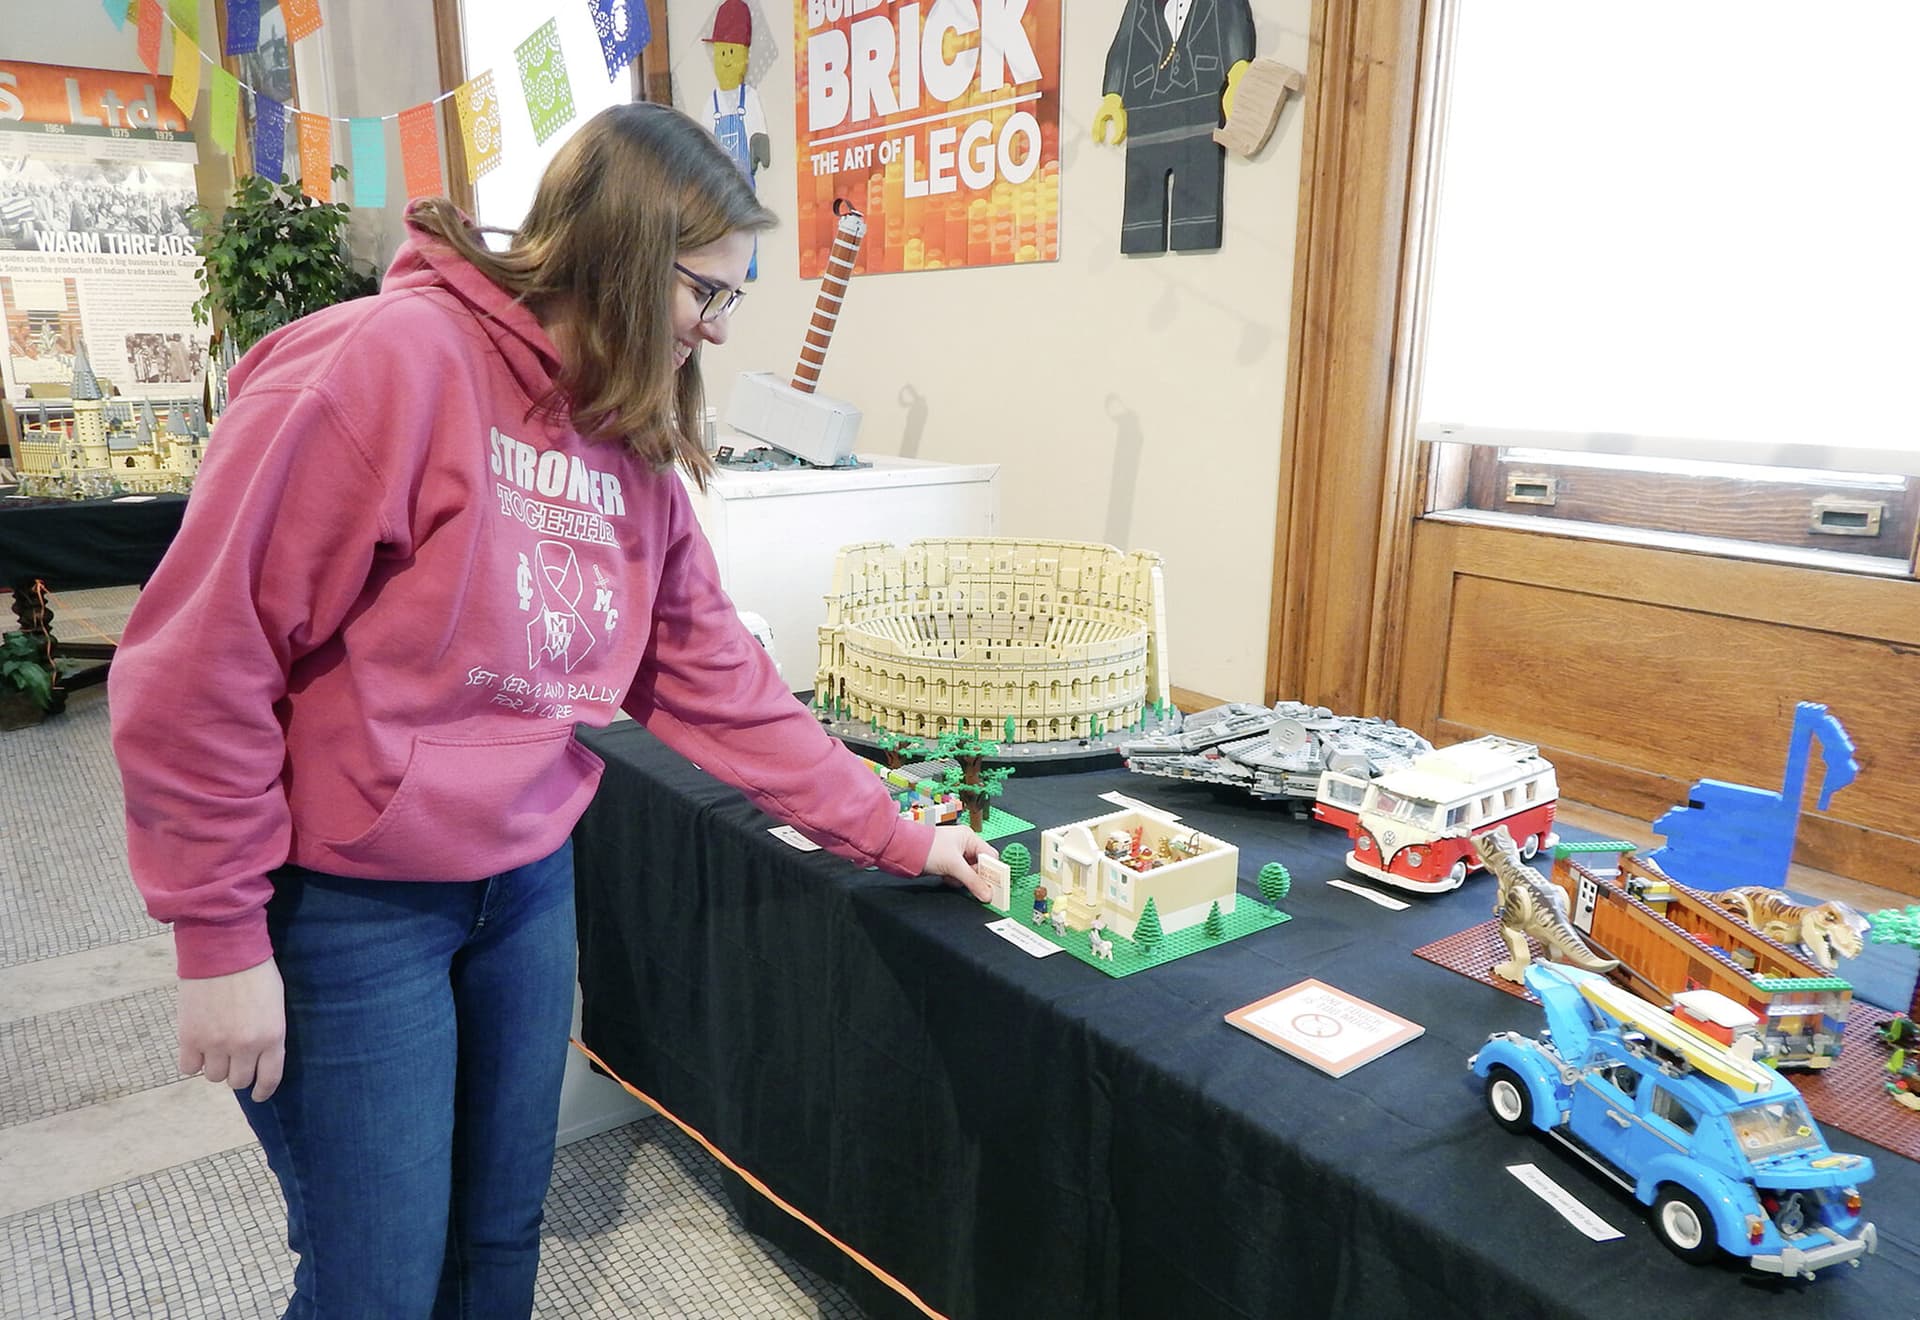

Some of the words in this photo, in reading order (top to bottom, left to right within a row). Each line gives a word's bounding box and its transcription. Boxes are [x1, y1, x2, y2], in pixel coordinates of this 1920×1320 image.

[807, 0, 1043, 132] BRICK
[65, 78, 178, 130] Ltd.
[110, 128, 130, 138] 1975
[155, 131, 174, 141] 1975
[810, 150, 839, 177] THE
[843, 143, 875, 171] ART
[878, 138, 902, 164] OF
[904, 111, 1042, 199] LEGO
[33, 230, 102, 254] WARM
[104, 233, 197, 257] THREADS
[544, 681, 565, 699] AND
[568, 683, 620, 704] RALLY
